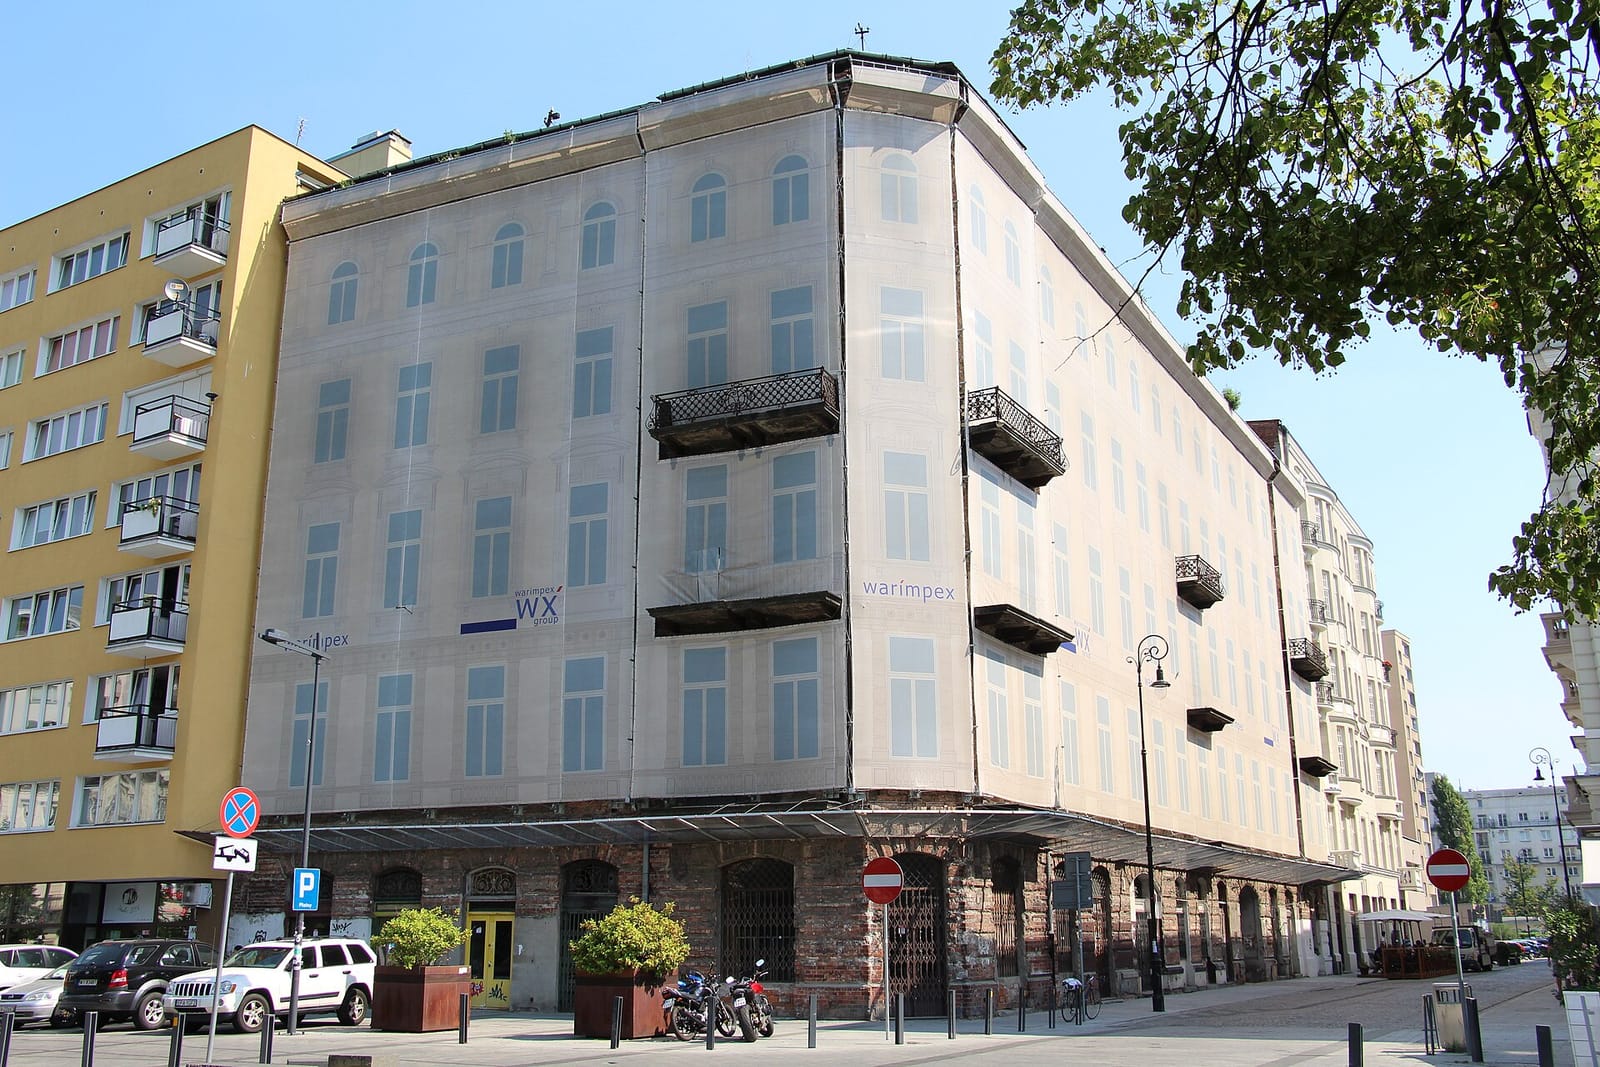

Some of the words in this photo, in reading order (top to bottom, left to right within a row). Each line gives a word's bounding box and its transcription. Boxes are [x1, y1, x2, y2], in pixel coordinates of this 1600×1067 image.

[516, 595, 557, 619] WX
[533, 616, 559, 627] group
[299, 872, 315, 898] P
